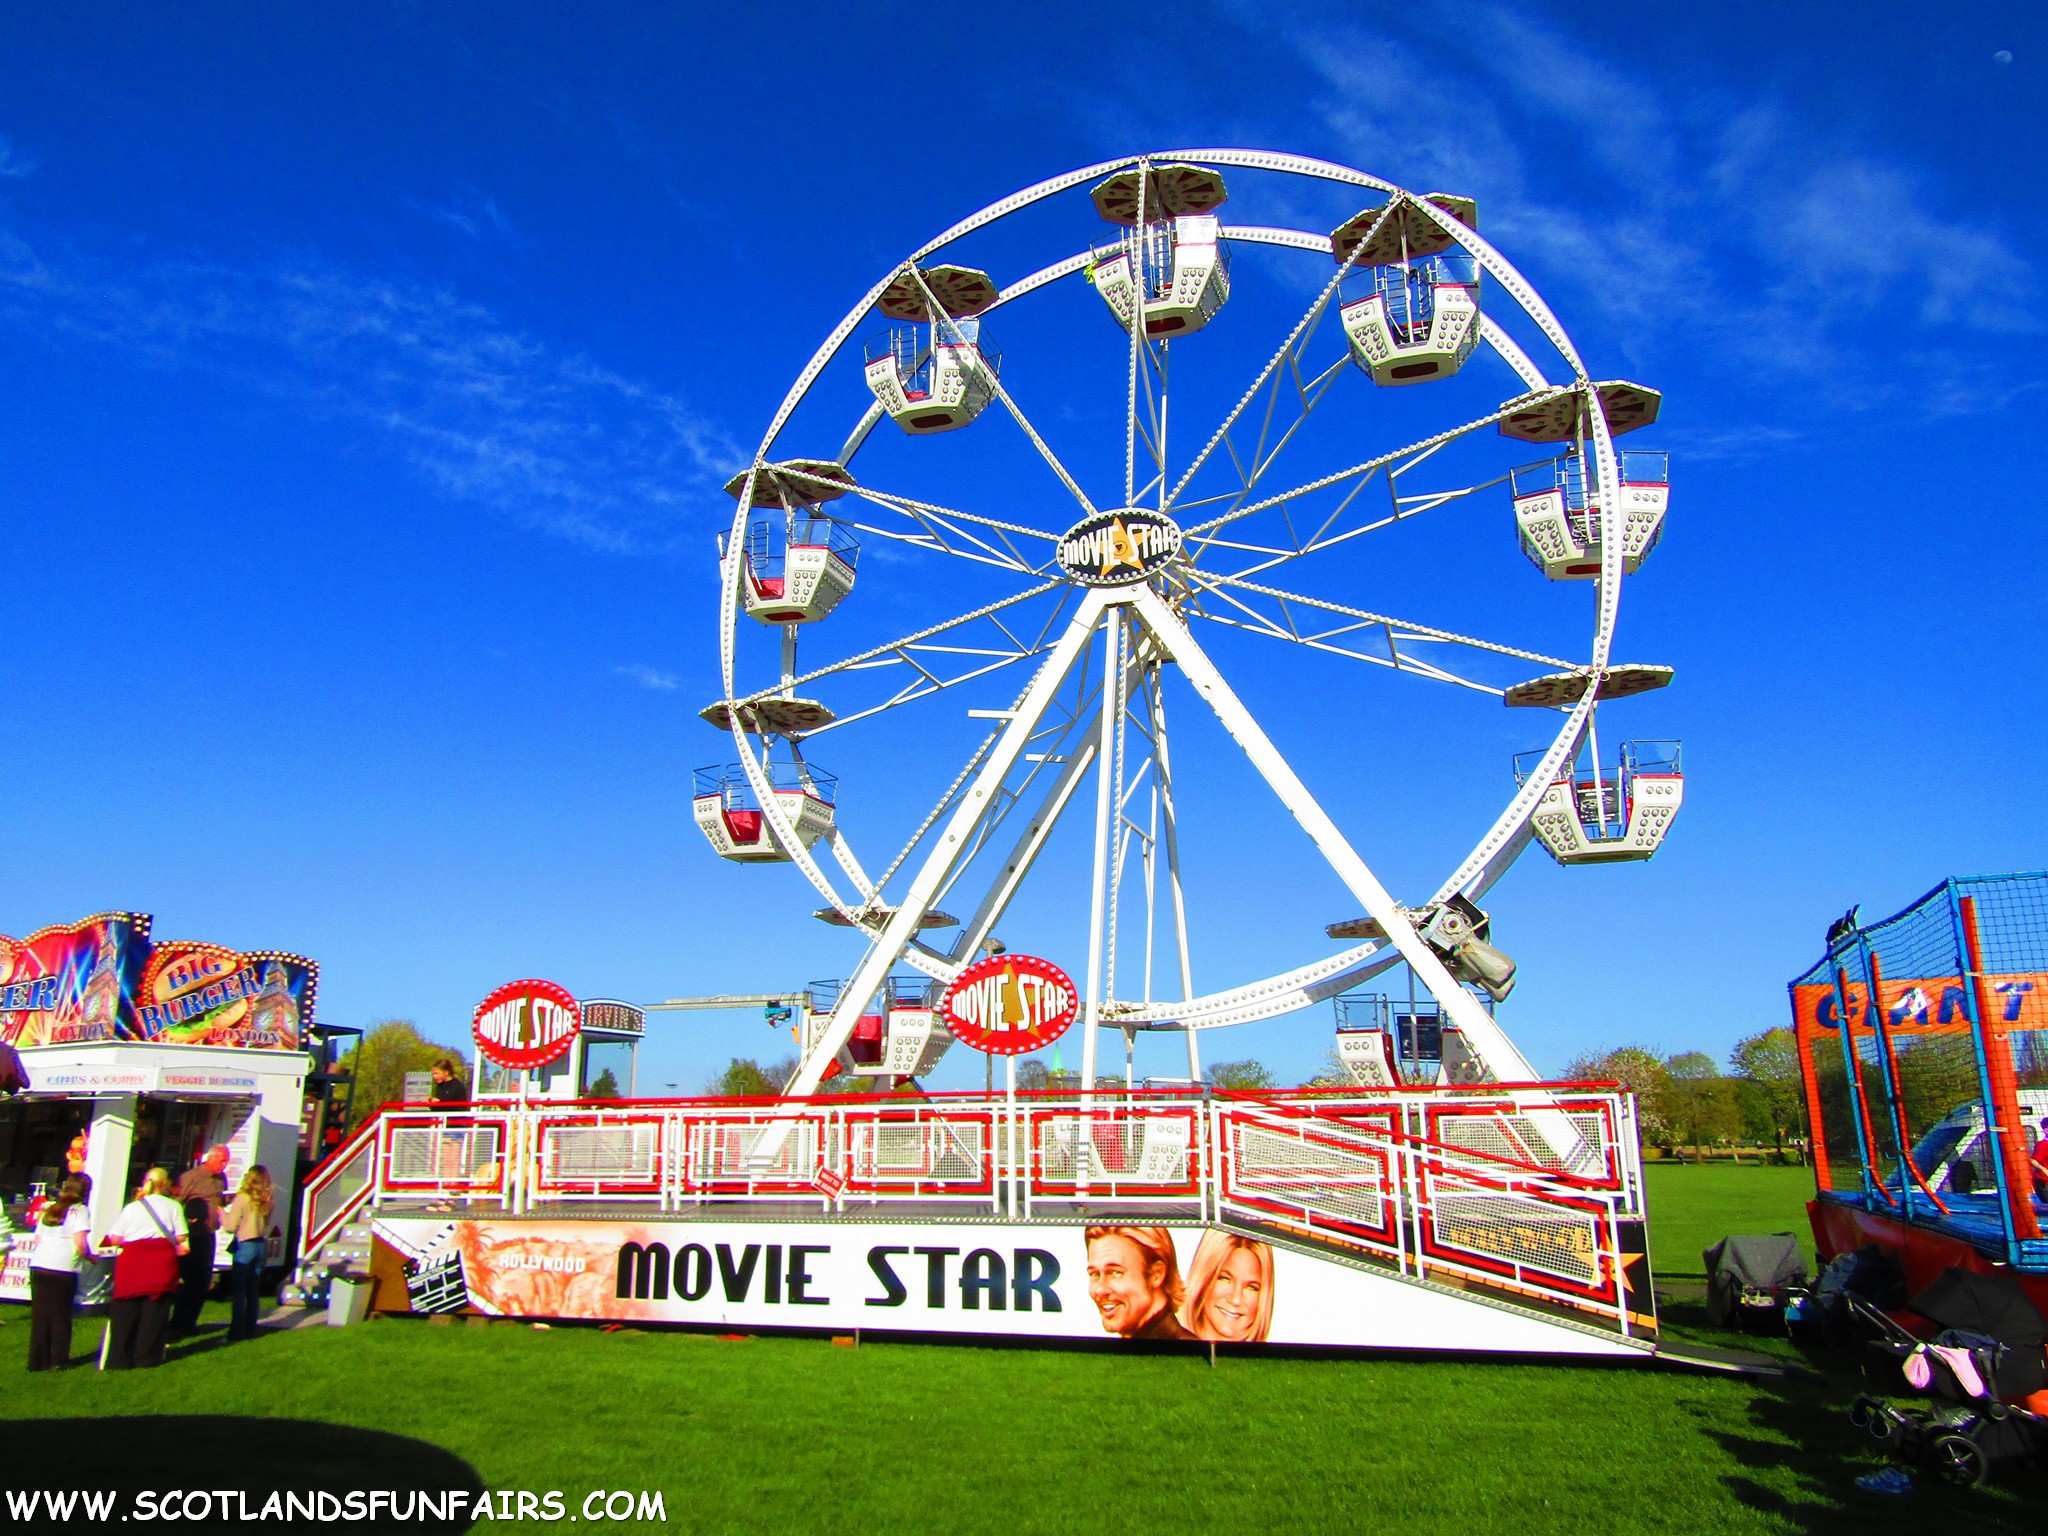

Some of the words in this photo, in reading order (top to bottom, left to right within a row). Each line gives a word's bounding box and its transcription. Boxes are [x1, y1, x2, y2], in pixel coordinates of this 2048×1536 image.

[1063, 525, 1121, 566] MOVIE
[1127, 523, 1175, 563] STAR
[167, 955, 222, 991] BIG
[138, 966, 264, 1040] BURGER
[952, 974, 1010, 1032] MOVIE
[1017, 973, 1069, 1031] STAR
[209, 1027, 279, 1043] LONDON
[479, 997, 527, 1050] MOVIE
[529, 997, 573, 1050] STAR
[90, 1075, 99, 1085] &
[165, 1075, 206, 1086] VEGGIE
[208, 1076, 255, 1087] BURGERS
[499, 1254, 586, 1274] HOLLYWOOD
[615, 1241, 831, 1306] MOVIE
[864, 1245, 1062, 1313] STAR
